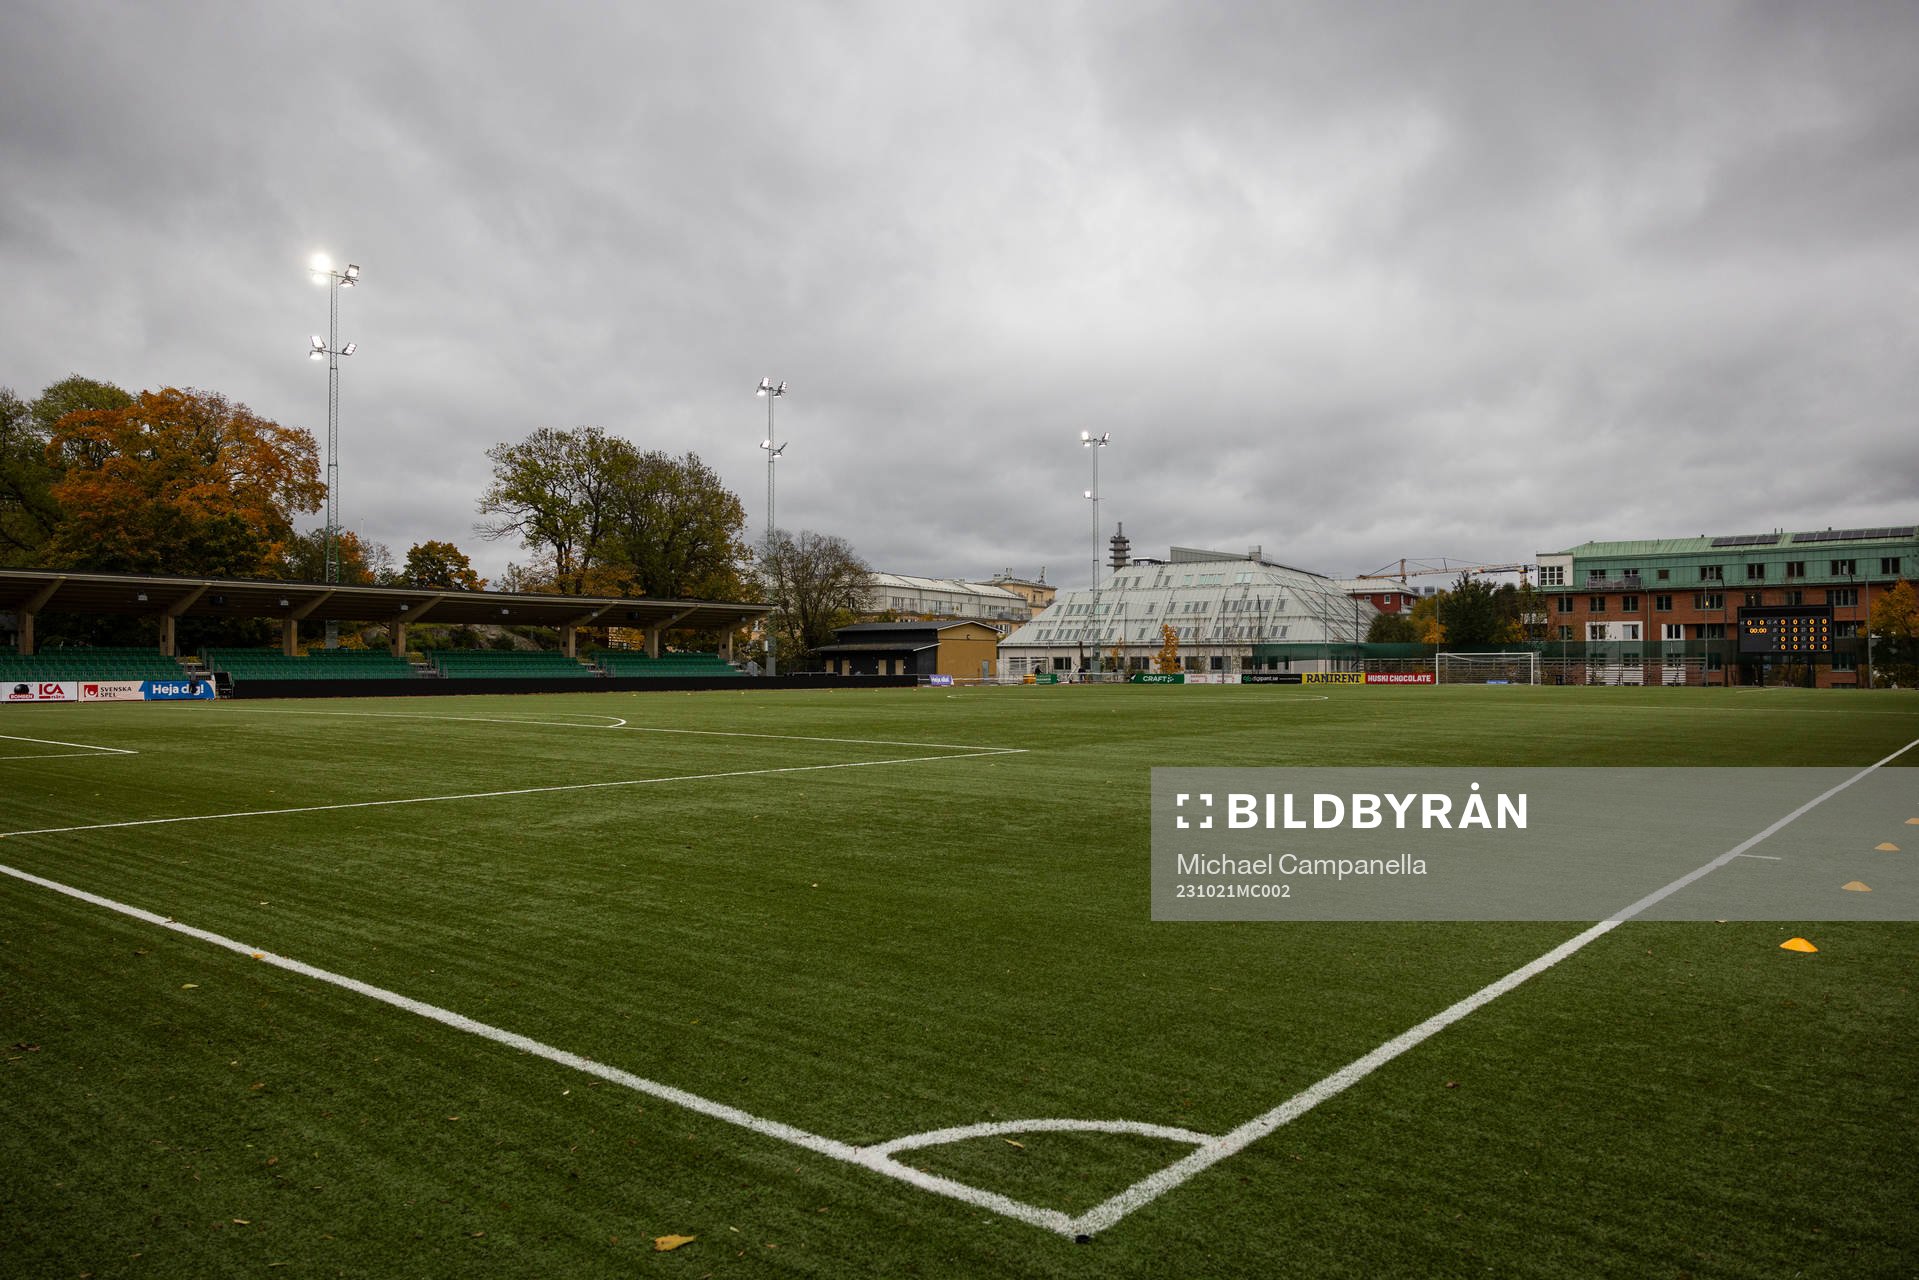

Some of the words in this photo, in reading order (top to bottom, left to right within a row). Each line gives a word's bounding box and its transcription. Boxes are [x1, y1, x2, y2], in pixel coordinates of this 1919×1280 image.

[1306, 673, 1361, 683] RAMIRENT
[1367, 674, 1388, 682] HUSKI
[1389, 674, 1431, 682] CHOCOLATE
[38, 683, 64, 695] ICA
[152, 684, 179, 696] Heja
[181, 684, 204, 696] dg!
